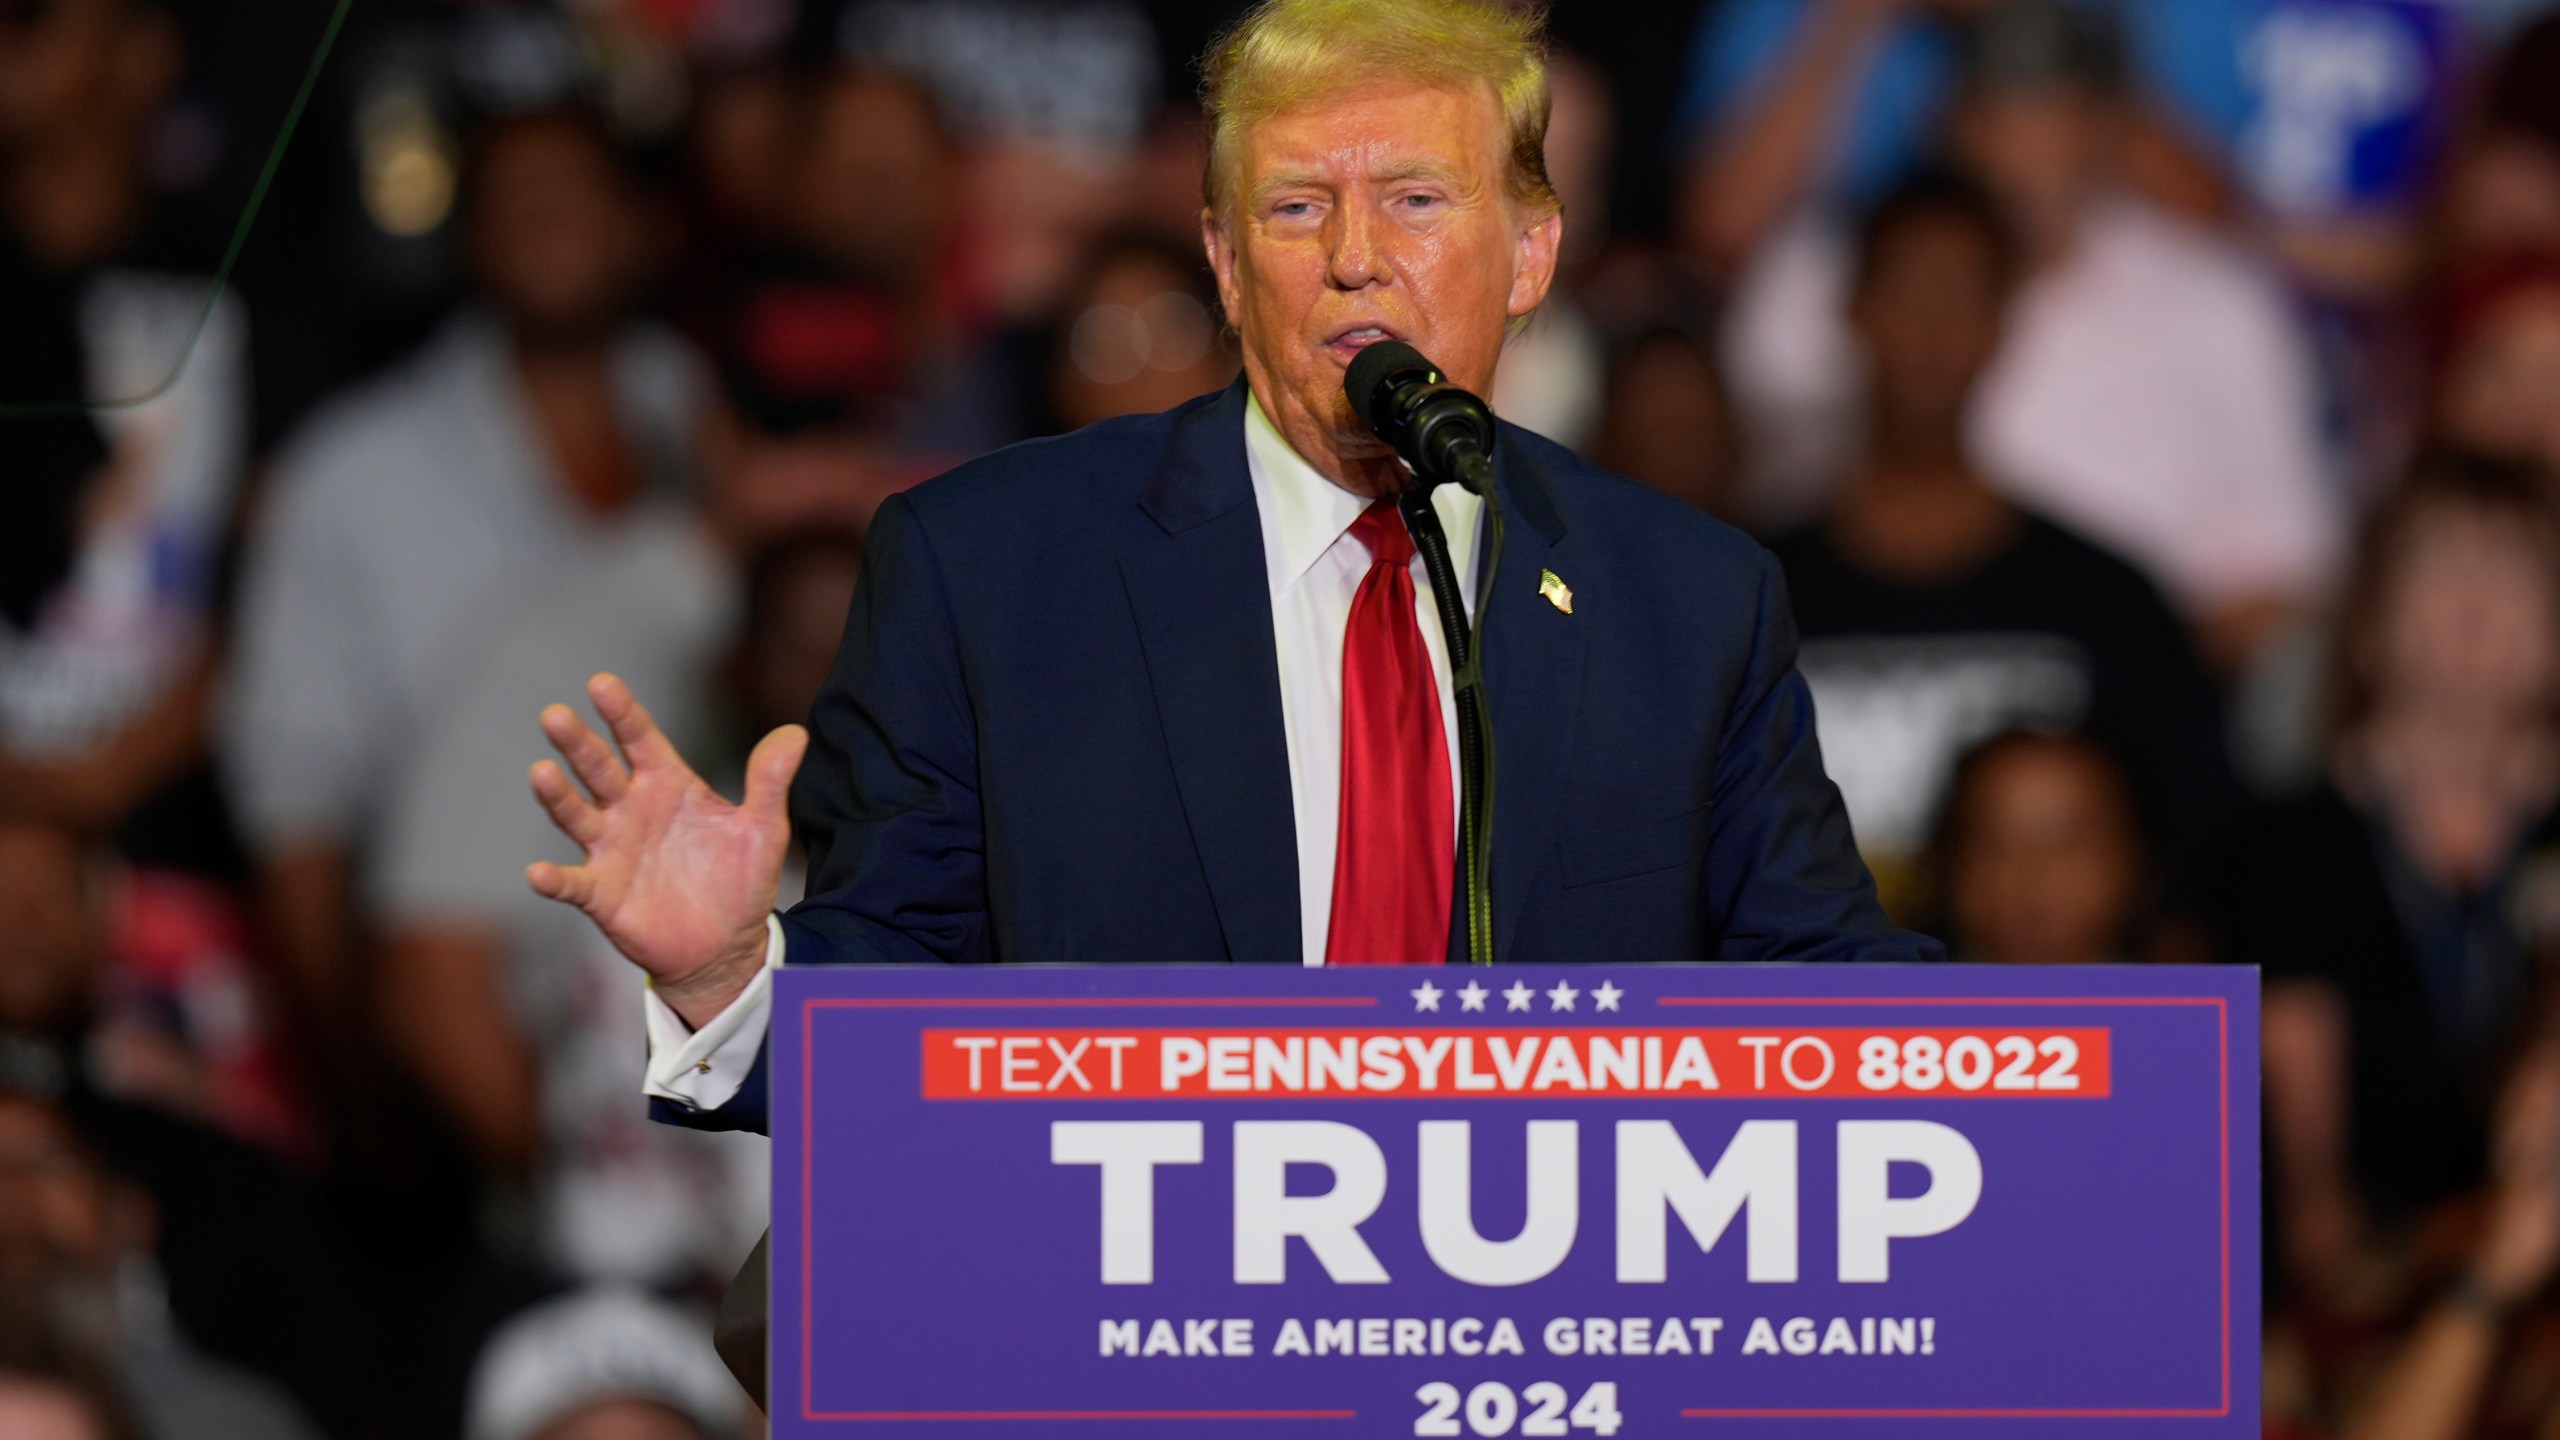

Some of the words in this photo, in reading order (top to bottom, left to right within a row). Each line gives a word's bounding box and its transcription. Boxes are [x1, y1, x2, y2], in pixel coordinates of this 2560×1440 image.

[954, 1037, 1137, 1091] TEXT
[1161, 1036, 1719, 1091] PENNSYLVANIA
[1738, 1036, 1834, 1091] TO
[1857, 1036, 2080, 1091] 88022
[1051, 1119, 1983, 1287] TRUMP
[1099, 1318, 1253, 1356] MAKE
[1273, 1318, 1524, 1356] AMERICA
[1544, 1318, 1723, 1356] GREAT
[1742, 1317, 1935, 1356] AGAIN!
[1414, 1381, 1622, 1438] 2024
